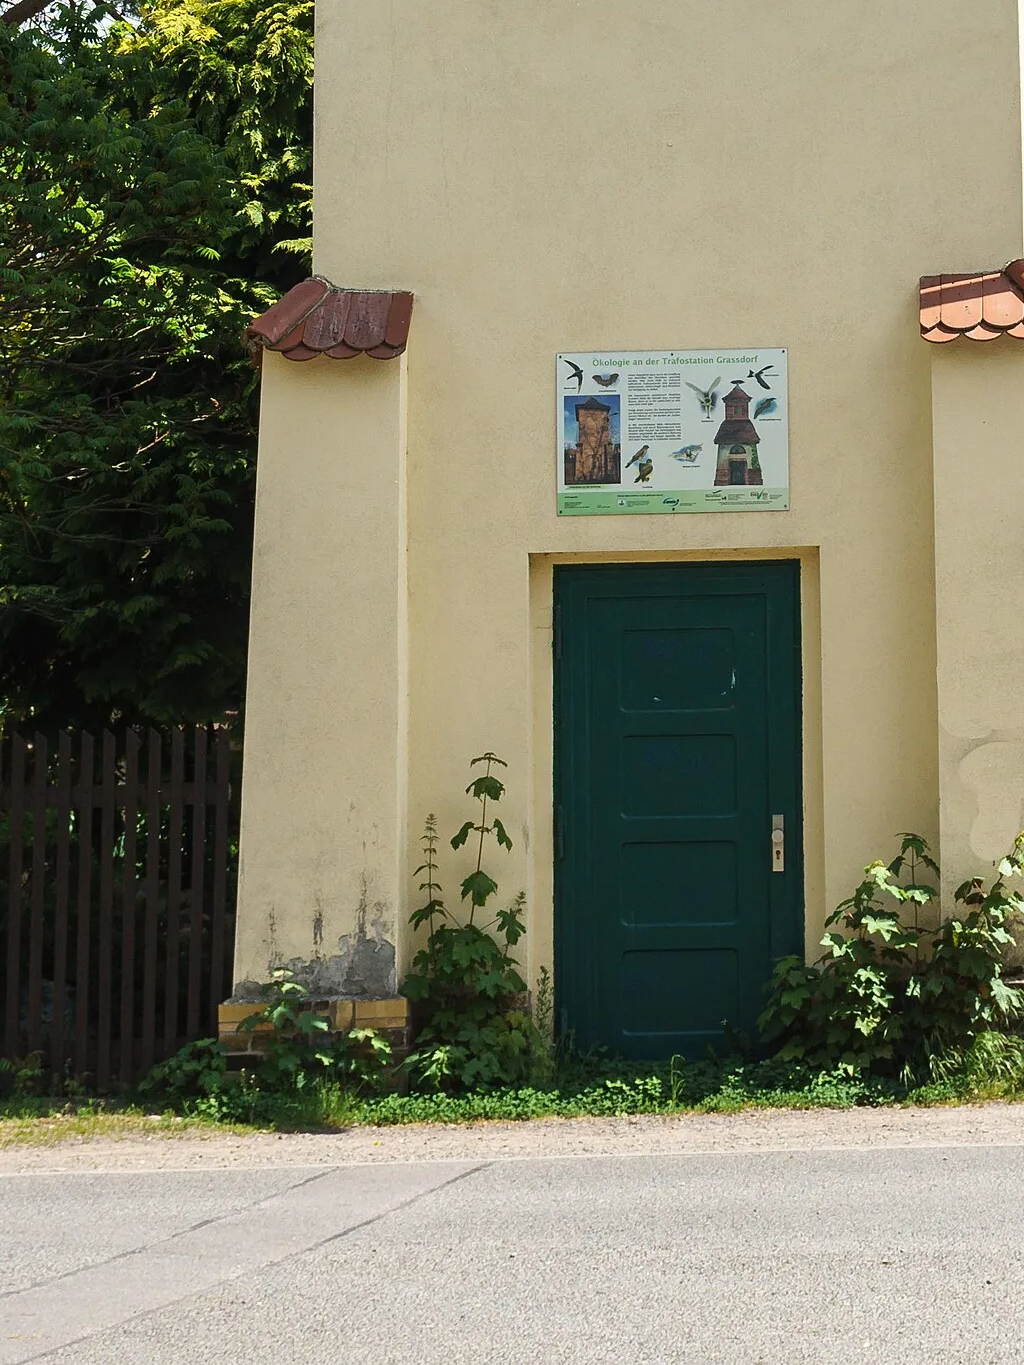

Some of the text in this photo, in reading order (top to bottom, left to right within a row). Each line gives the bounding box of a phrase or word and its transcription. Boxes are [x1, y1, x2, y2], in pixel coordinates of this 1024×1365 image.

[592, 357, 630, 368] Ökologie
[662, 356, 714, 365] Trafostation
[716, 355, 759, 364] Grassdorf
